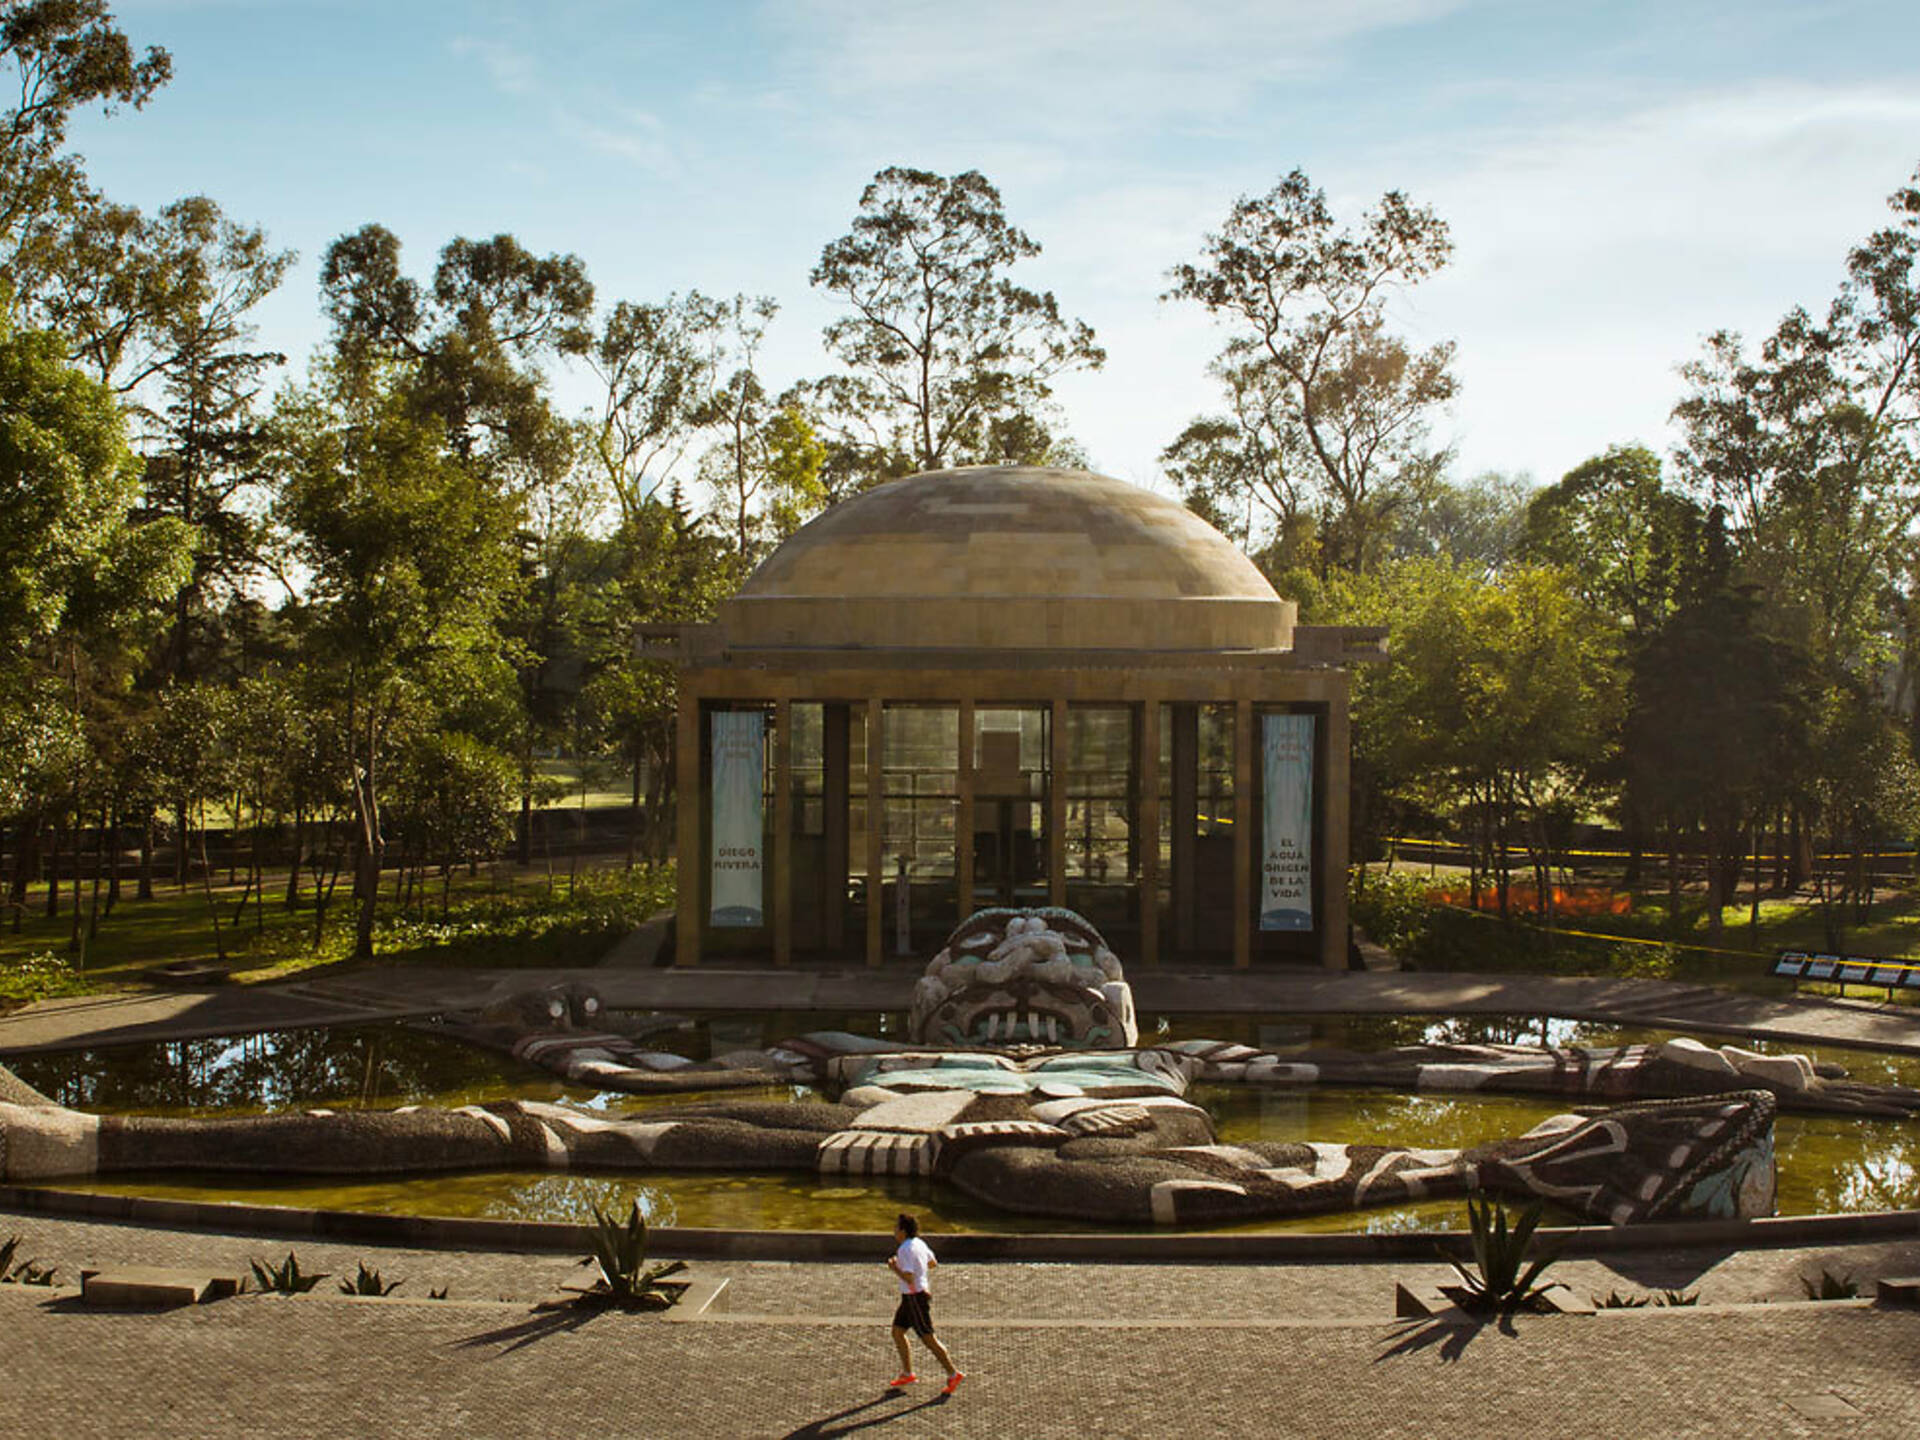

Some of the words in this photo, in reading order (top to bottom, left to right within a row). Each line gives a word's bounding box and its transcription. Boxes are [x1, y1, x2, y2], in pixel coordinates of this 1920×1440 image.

[718, 847, 755, 857] DIEGO
[1269, 851, 1304, 860] AGUA
[714, 860, 761, 870] RIVERA
[1264, 863, 1309, 873] ORIGEN
[1271, 888, 1301, 898] VIDA
